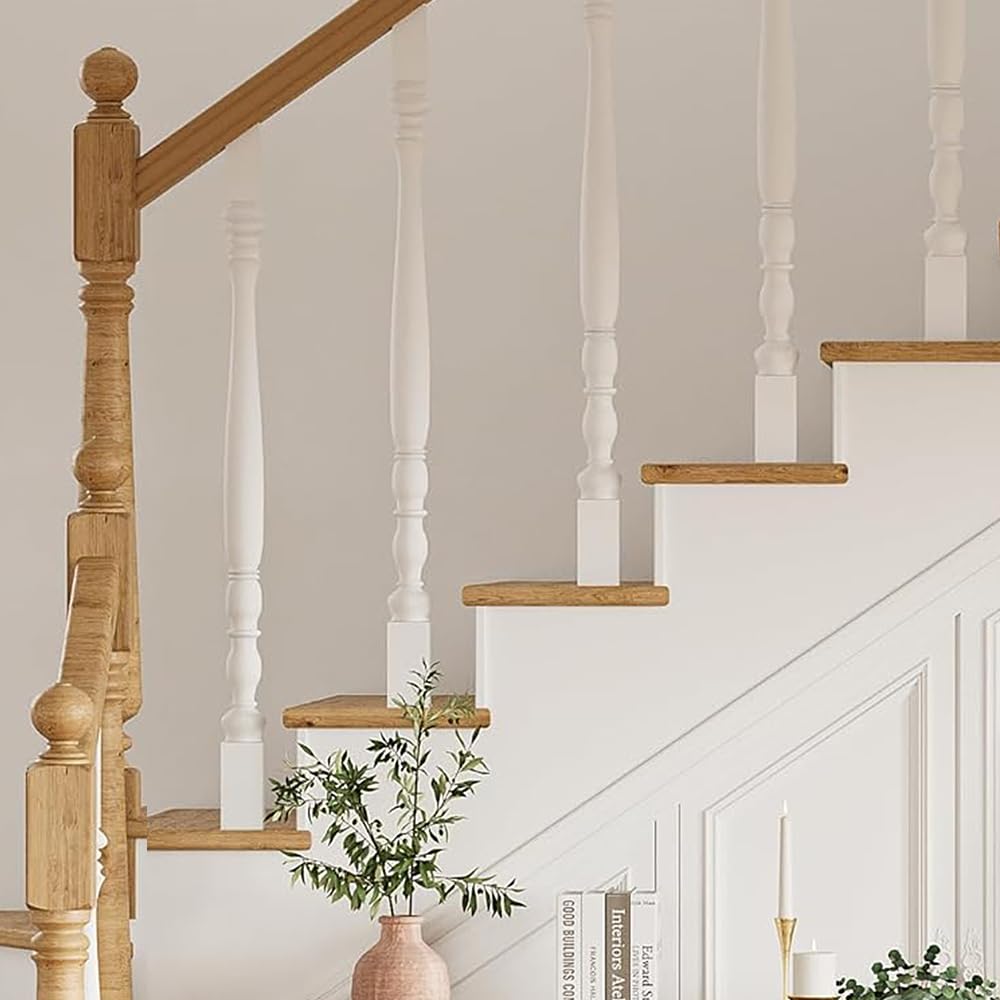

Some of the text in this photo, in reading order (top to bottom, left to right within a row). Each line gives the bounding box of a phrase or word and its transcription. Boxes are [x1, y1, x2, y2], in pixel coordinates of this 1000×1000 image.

[562, 899, 575, 927] GOOD
[562, 929, 575, 981] BUILDINGS
[611, 908, 626, 971] Interiors
[641, 945, 654, 987] Edward
